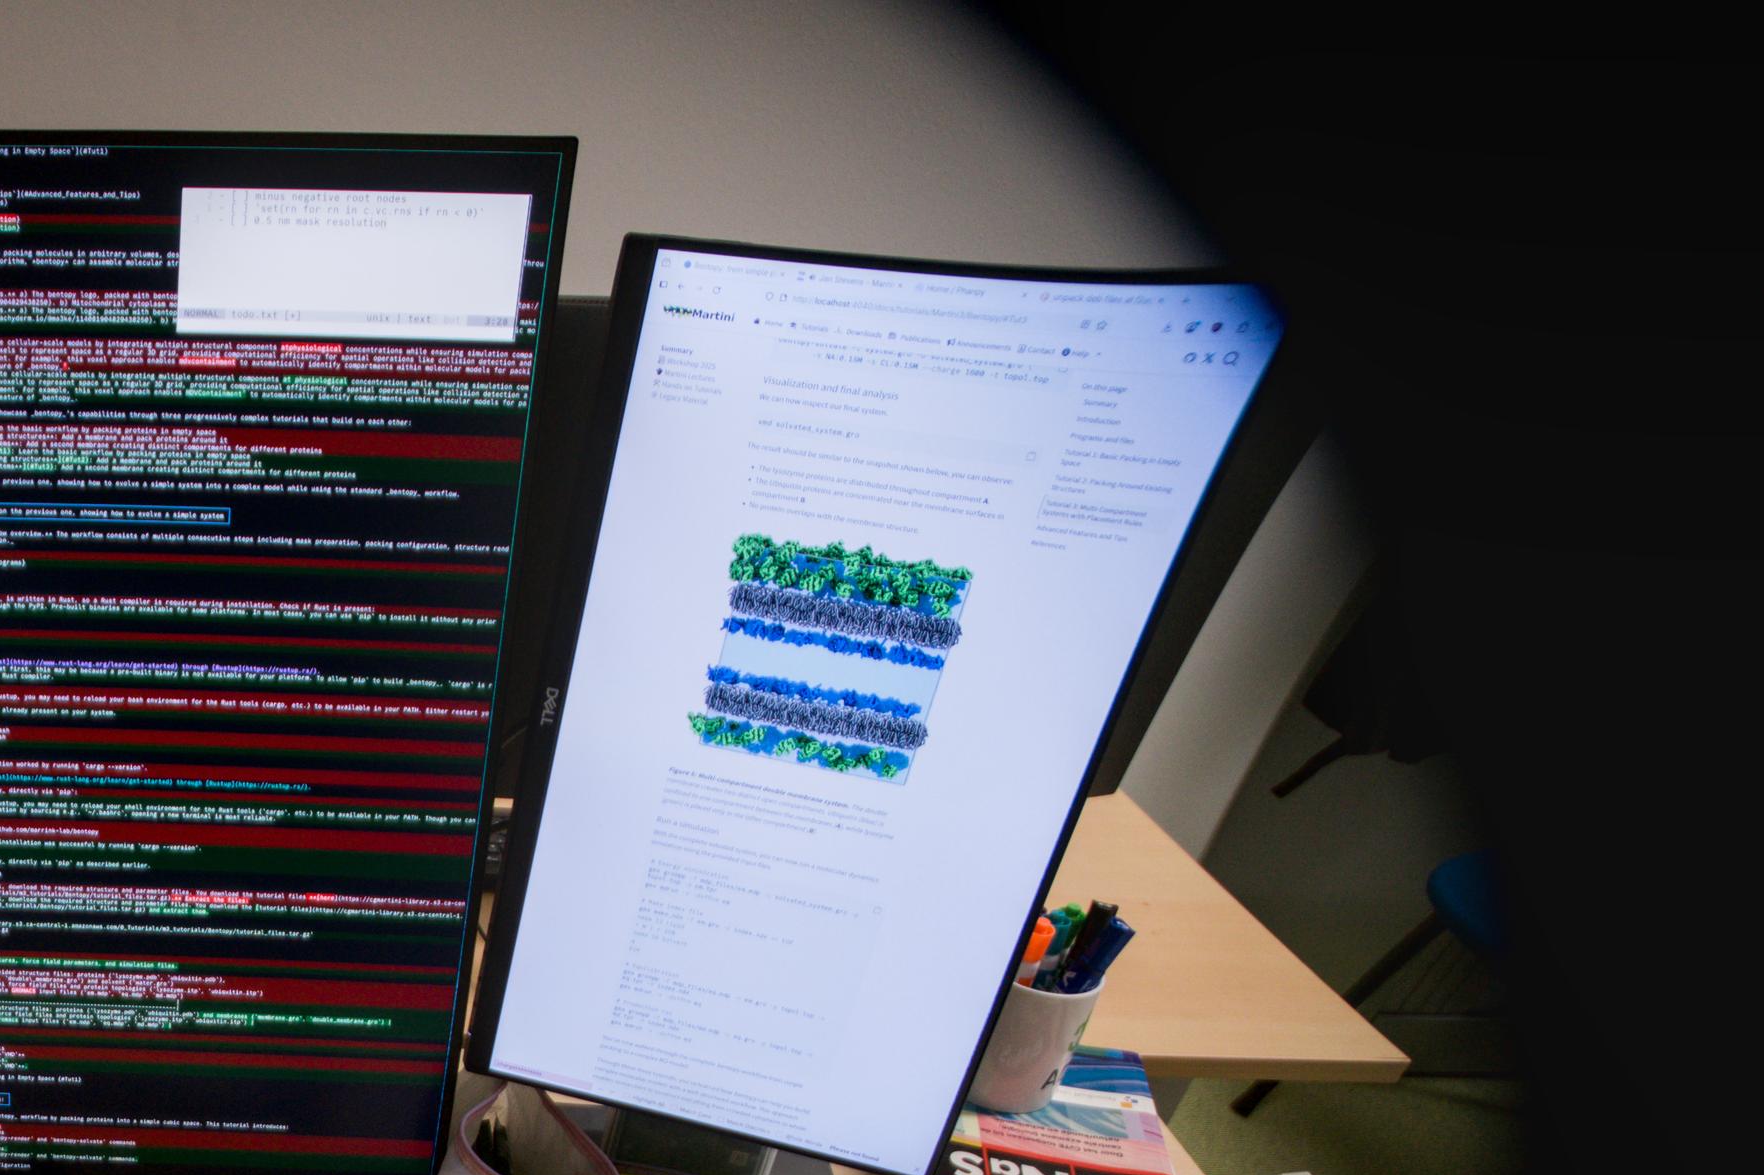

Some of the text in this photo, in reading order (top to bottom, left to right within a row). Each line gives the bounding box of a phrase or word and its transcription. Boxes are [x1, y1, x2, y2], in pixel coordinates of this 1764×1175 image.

[12, 147, 21, 155] in
[24, 147, 46, 156] Empty
[255, 192, 407, 204] minus negative root nodes
[304, 204, 321, 214] for
[328, 206, 340, 216] rn
[346, 206, 360, 216] in
[418, 206, 430, 216] if
[436, 208, 449, 218] rn
[254, 216, 388, 229] 0.5 nm mask resolution
[183, 309, 220, 319] NORMAL
[231, 310, 278, 320] todo.txt
[366, 313, 390, 324] unix
[408, 314, 432, 325] text
[692, 308, 735, 322] Martini
[661, 344, 693, 356] Summary
[1028, 346, 1056, 354] Contact
[763, 376, 900, 402] Visualization and final analysis
[78, 410, 126, 418] capabilities
[130, 410, 158, 420] through
[184, 412, 236, 422] progressively
[240, 413, 269, 422] complex
[272, 414, 308, 423] tutorials
[312, 415, 328, 424] that
[332, 416, 353, 424] build
[368, 417, 384, 425] each
[540, 686, 559, 726] DELL
